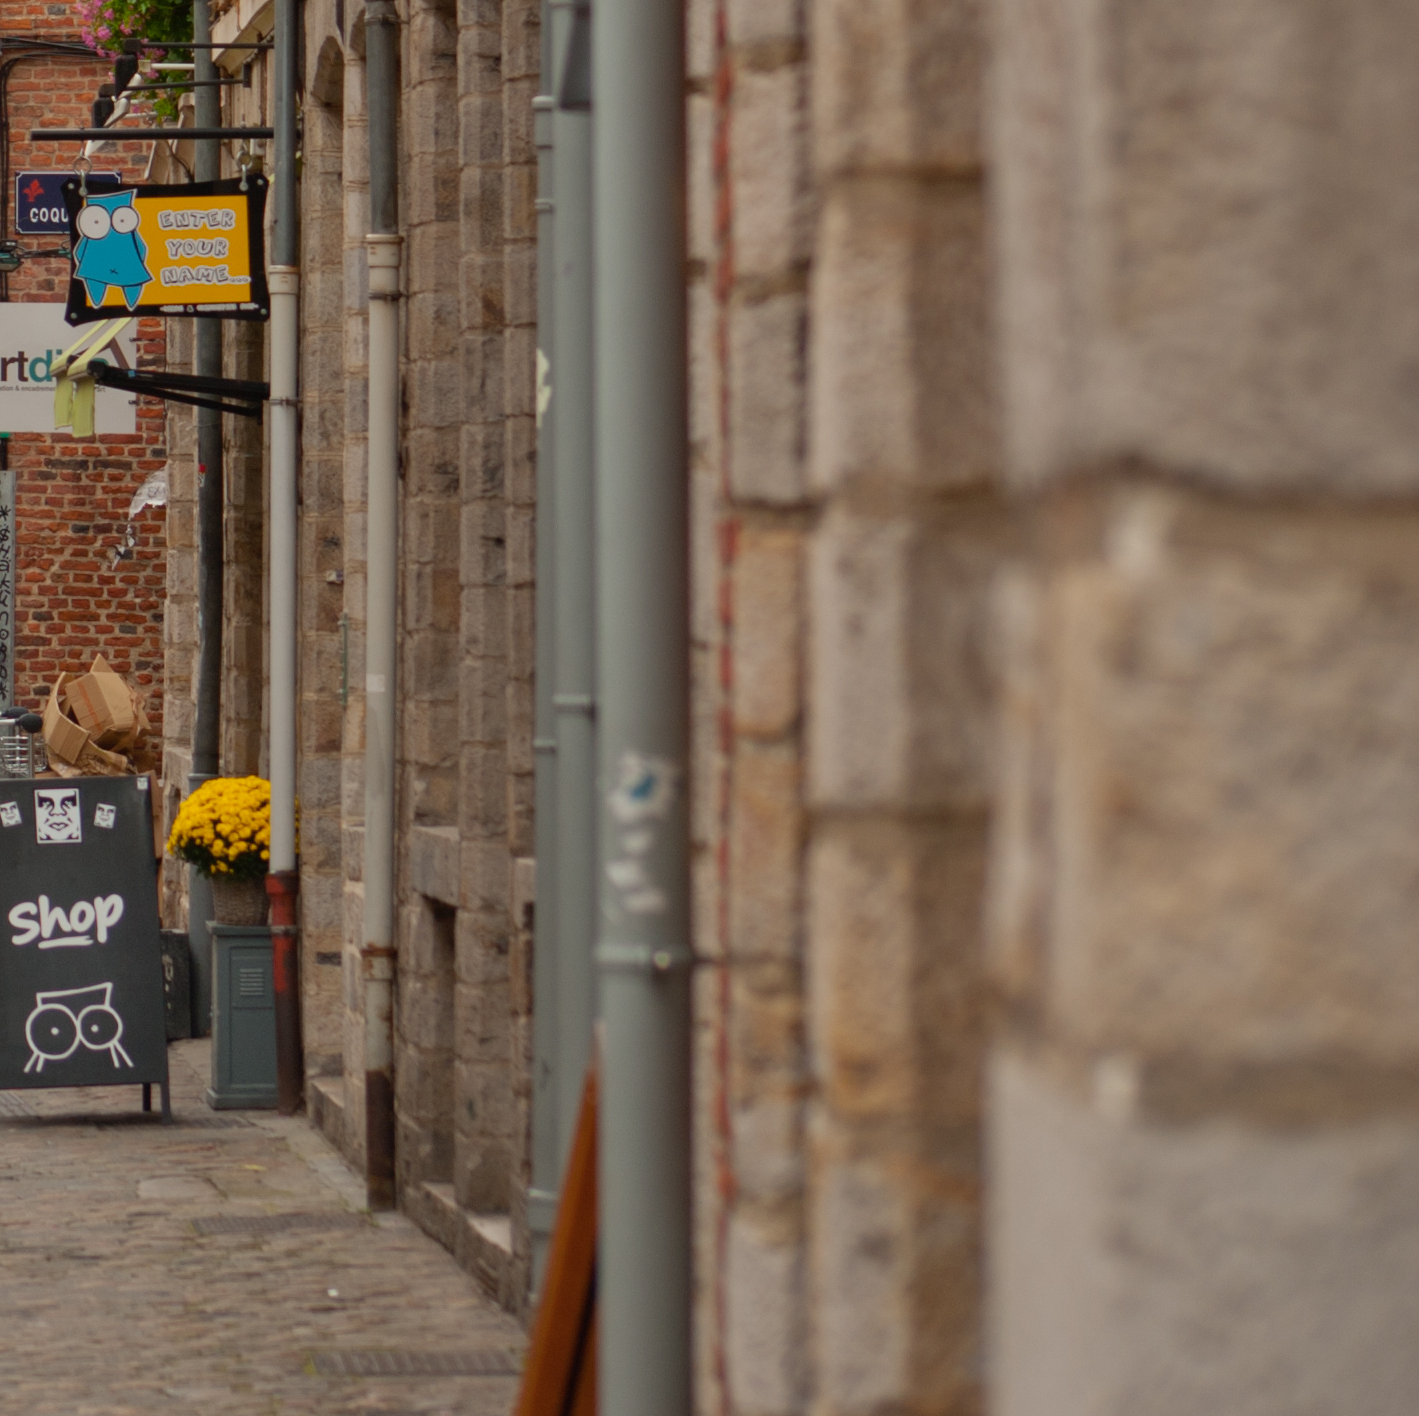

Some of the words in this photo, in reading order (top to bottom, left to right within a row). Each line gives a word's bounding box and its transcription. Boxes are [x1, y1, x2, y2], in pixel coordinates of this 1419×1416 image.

[159, 210, 235, 229] ENTER
[167, 239, 227, 257] YOUR
[8, 893, 124, 946] Shop
